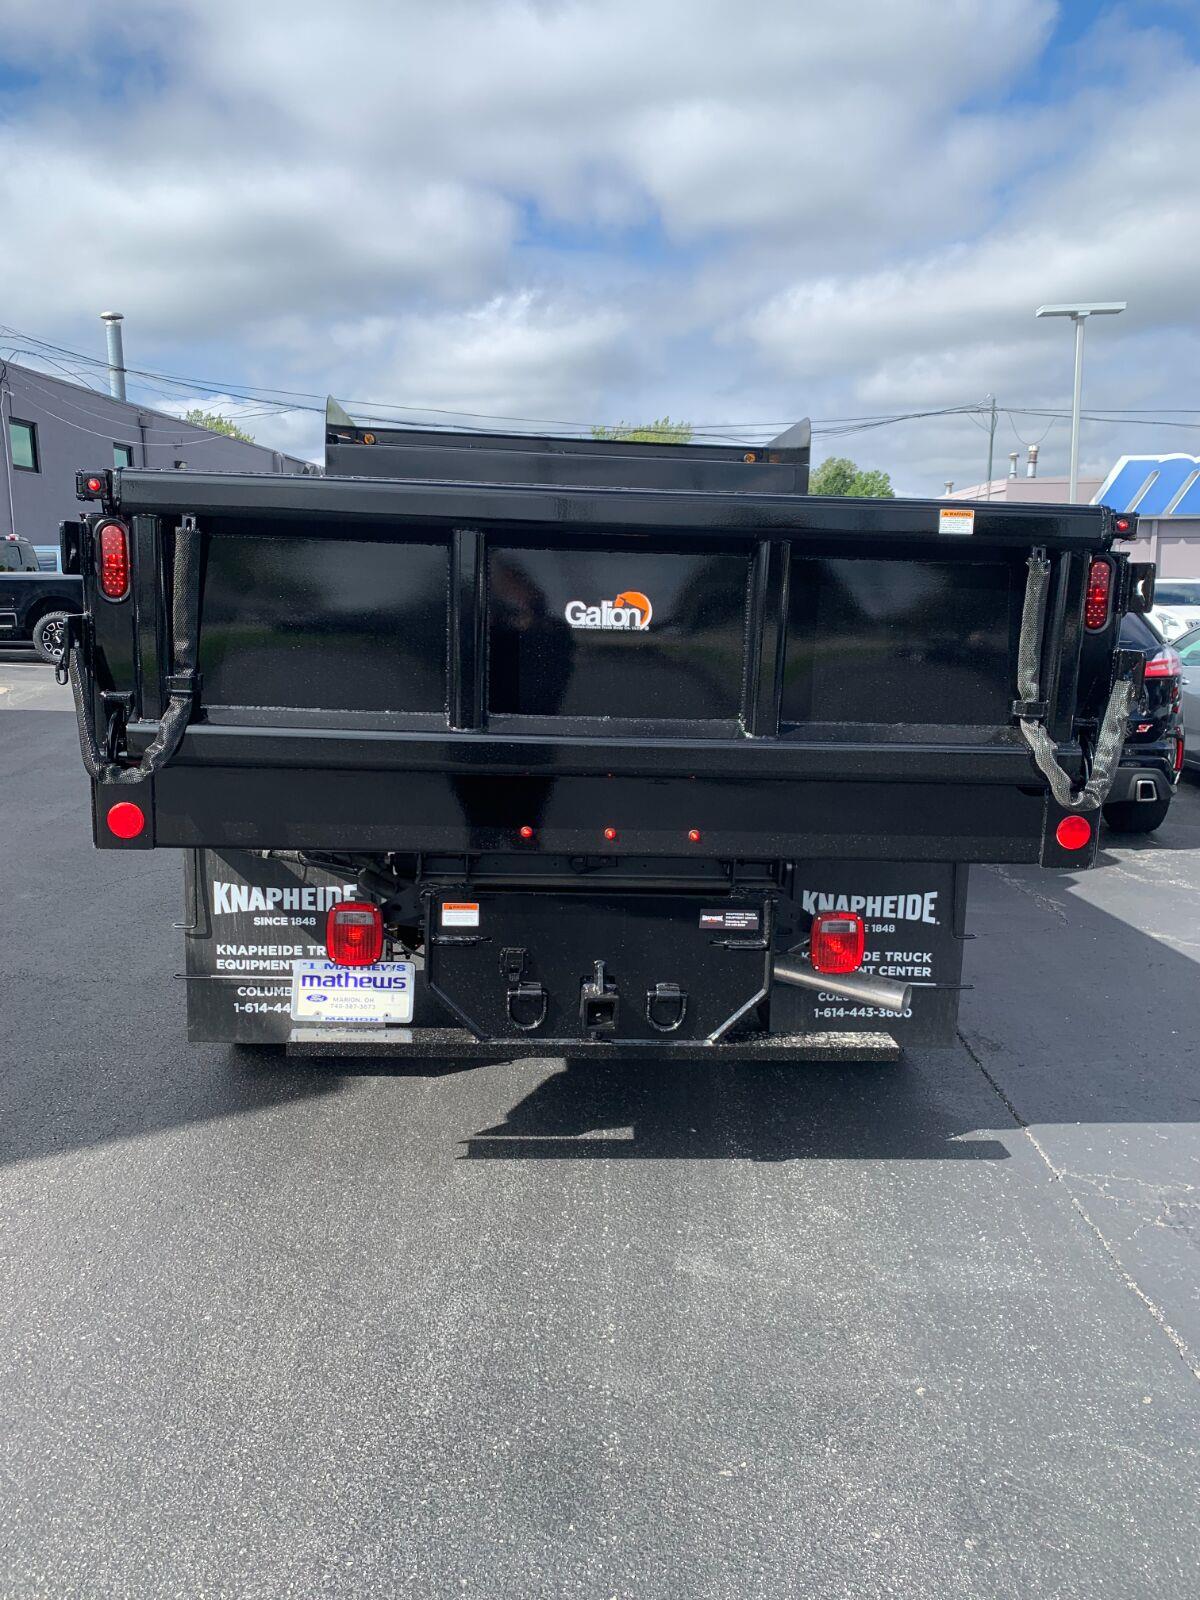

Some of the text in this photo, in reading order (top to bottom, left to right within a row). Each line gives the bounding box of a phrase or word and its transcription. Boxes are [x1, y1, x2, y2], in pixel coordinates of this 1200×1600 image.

[565, 600, 641, 626] Galion
[213, 880, 358, 915] KNAPHEIDE
[803, 890, 938, 924] KNAPHEIDE
[253, 916, 317, 926] SINCE 1848
[871, 924, 896, 933] 1848
[216, 944, 303, 956] KNAPHEIDE
[885, 951, 933, 963] TRUCK
[879, 965, 932, 977] CENTER
[302, 972, 407, 989] mathews
[237, 987, 292, 996] COLUMB
